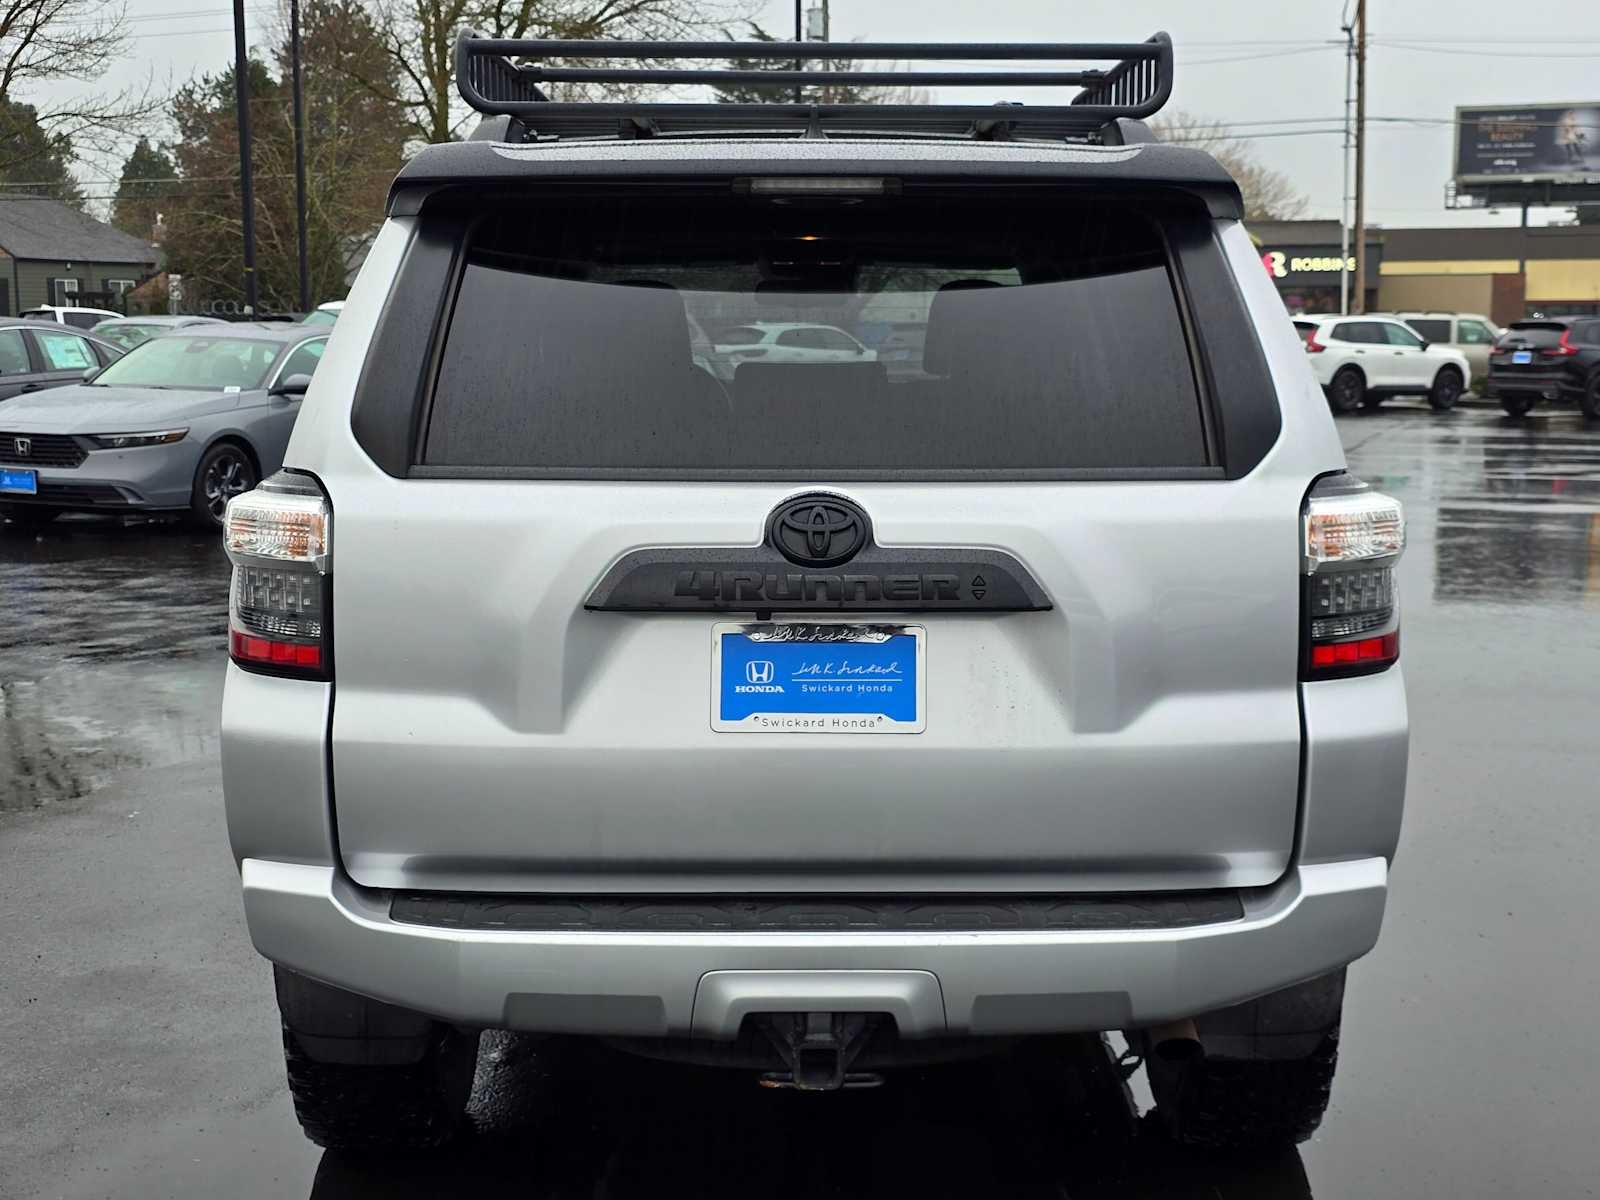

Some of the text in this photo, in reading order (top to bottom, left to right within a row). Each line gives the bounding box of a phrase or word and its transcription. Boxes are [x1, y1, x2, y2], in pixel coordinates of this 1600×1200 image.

[674, 570, 961, 601] 4RUNNER
[735, 685, 784, 693] HONDA
[801, 684, 893, 692] Swickard Honda
[761, 718, 876, 728] Swickard Honda
